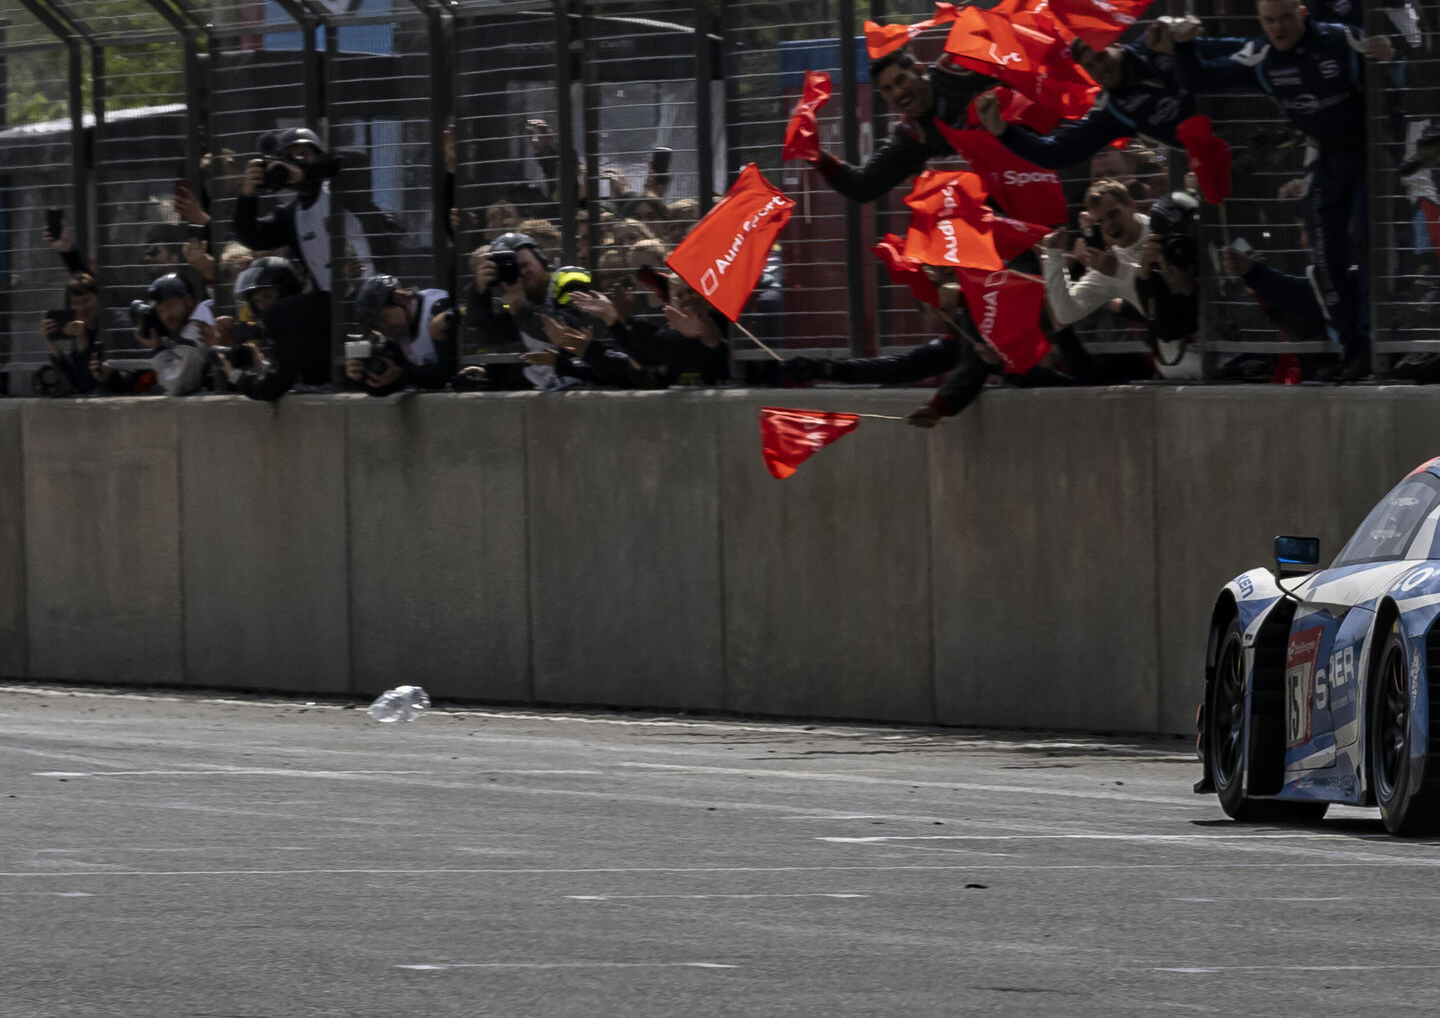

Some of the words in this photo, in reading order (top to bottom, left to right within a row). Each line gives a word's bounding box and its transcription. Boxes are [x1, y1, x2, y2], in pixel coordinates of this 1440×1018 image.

[1003, 170, 1060, 187] Sport
[715, 233, 745, 275] Audi
[937, 219, 961, 264] Audi
